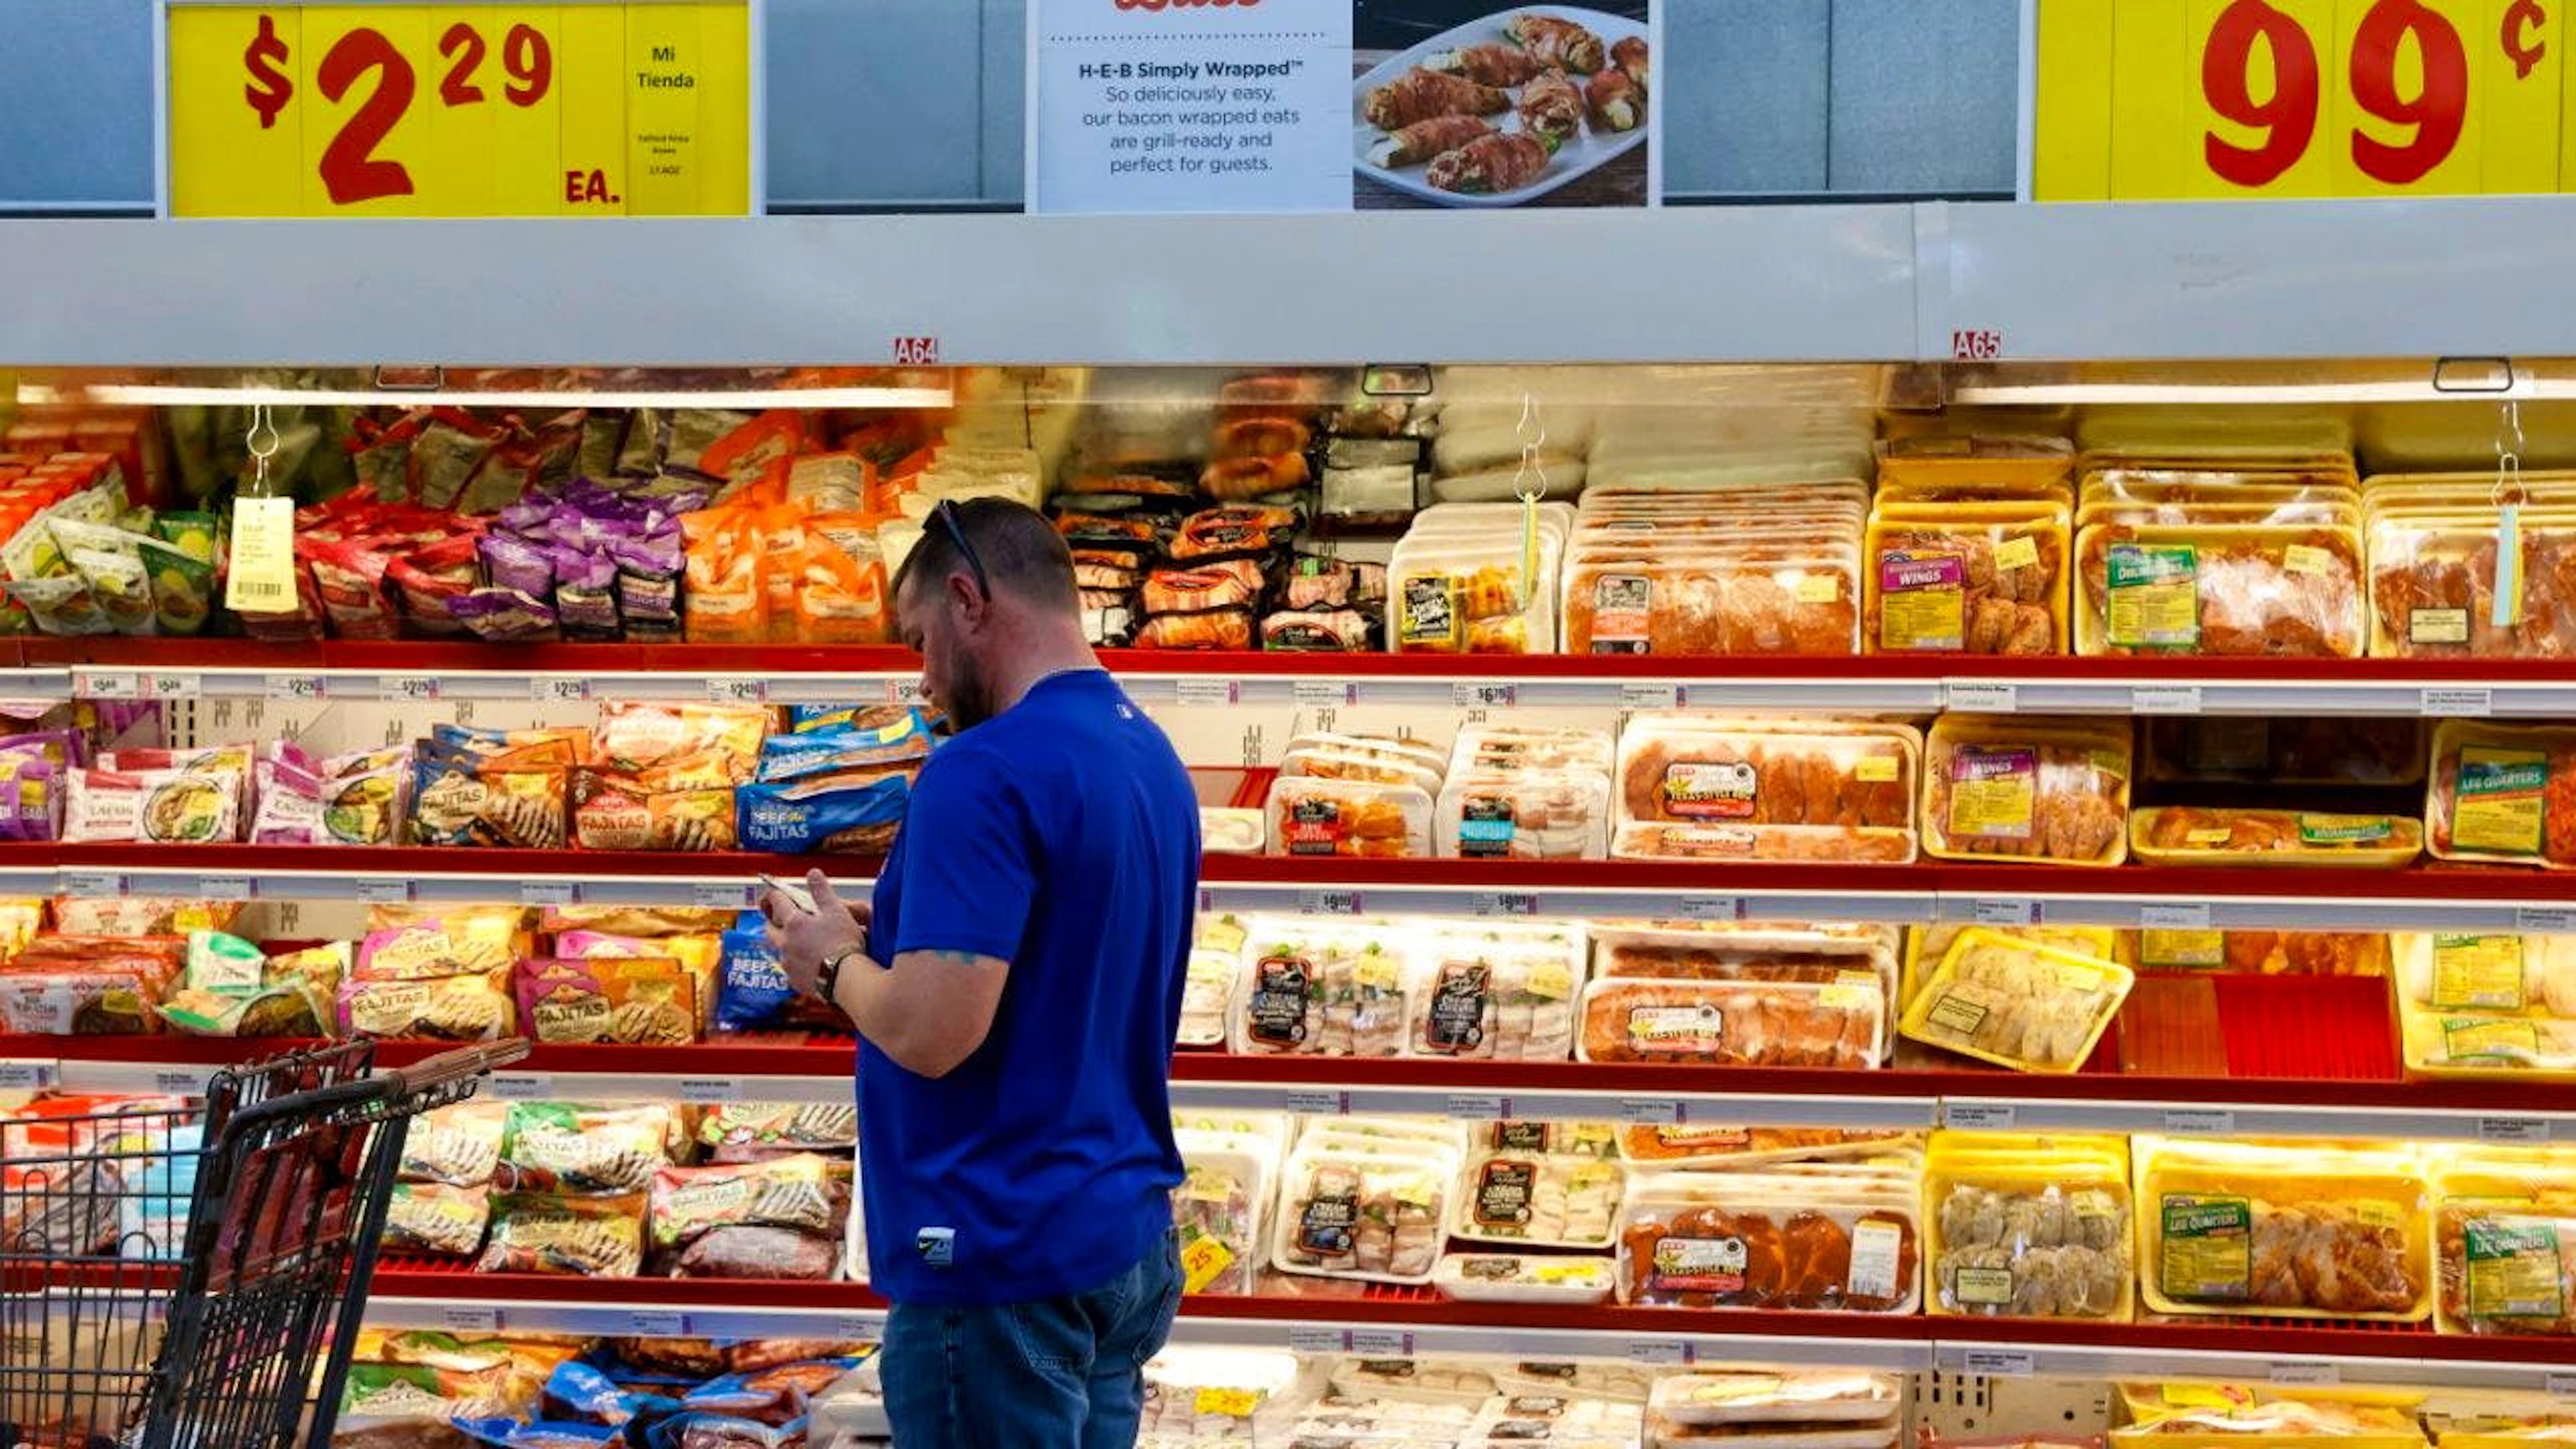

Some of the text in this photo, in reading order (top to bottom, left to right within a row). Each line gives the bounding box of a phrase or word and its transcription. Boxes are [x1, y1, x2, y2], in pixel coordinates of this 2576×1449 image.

[652, 46, 675, 61] Mi
[637, 73, 695, 88] Tienda
[1079, 63, 1132, 78] H-E-B
[1138, 62, 1198, 81] Simply
[1106, 87, 1277, 103] So deliciously easy,
[1082, 109, 1300, 128] our bacon wrapped eats
[1110, 133, 1273, 152] are grill-ready and
[1110, 156, 1273, 175] perfect for guests.
[565, 170, 621, 203] EA.
[895, 337, 938, 363] A64
[1955, 331, 2001, 358] A65
[1899, 568, 1941, 586] WINGS
[1971, 760, 2013, 776] WINGS
[2462, 771, 2542, 790] LEG QUARTERS
[748, 824, 808, 839] FAJITAS
[732, 957, 769, 973] BEEF
[539, 1004, 605, 1022] FAJITAS
[2188, 1212, 2240, 1230] QUARTERS
